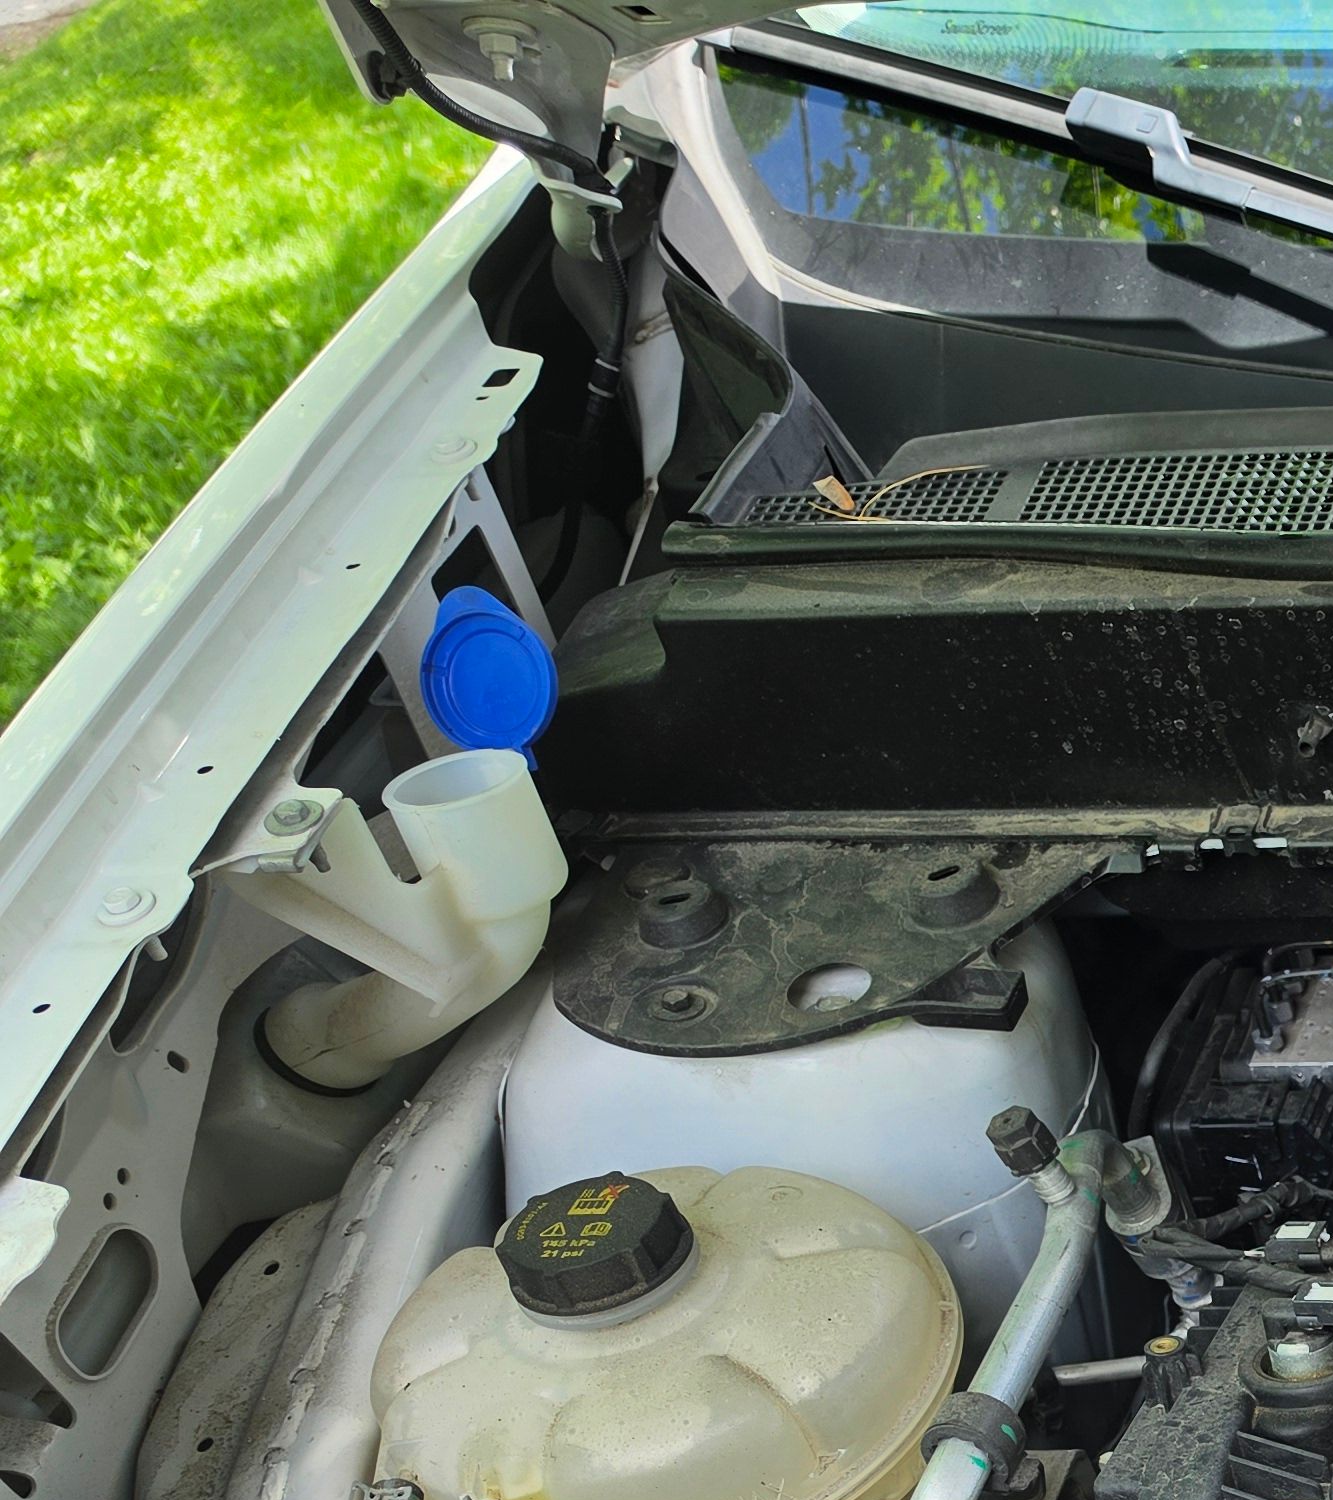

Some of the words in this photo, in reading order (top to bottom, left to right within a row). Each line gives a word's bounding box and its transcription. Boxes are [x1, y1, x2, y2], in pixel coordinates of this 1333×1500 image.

[542, 1239, 567, 1247] 145
[540, 1250, 557, 1258] 21
[561, 1249, 585, 1259] psi
